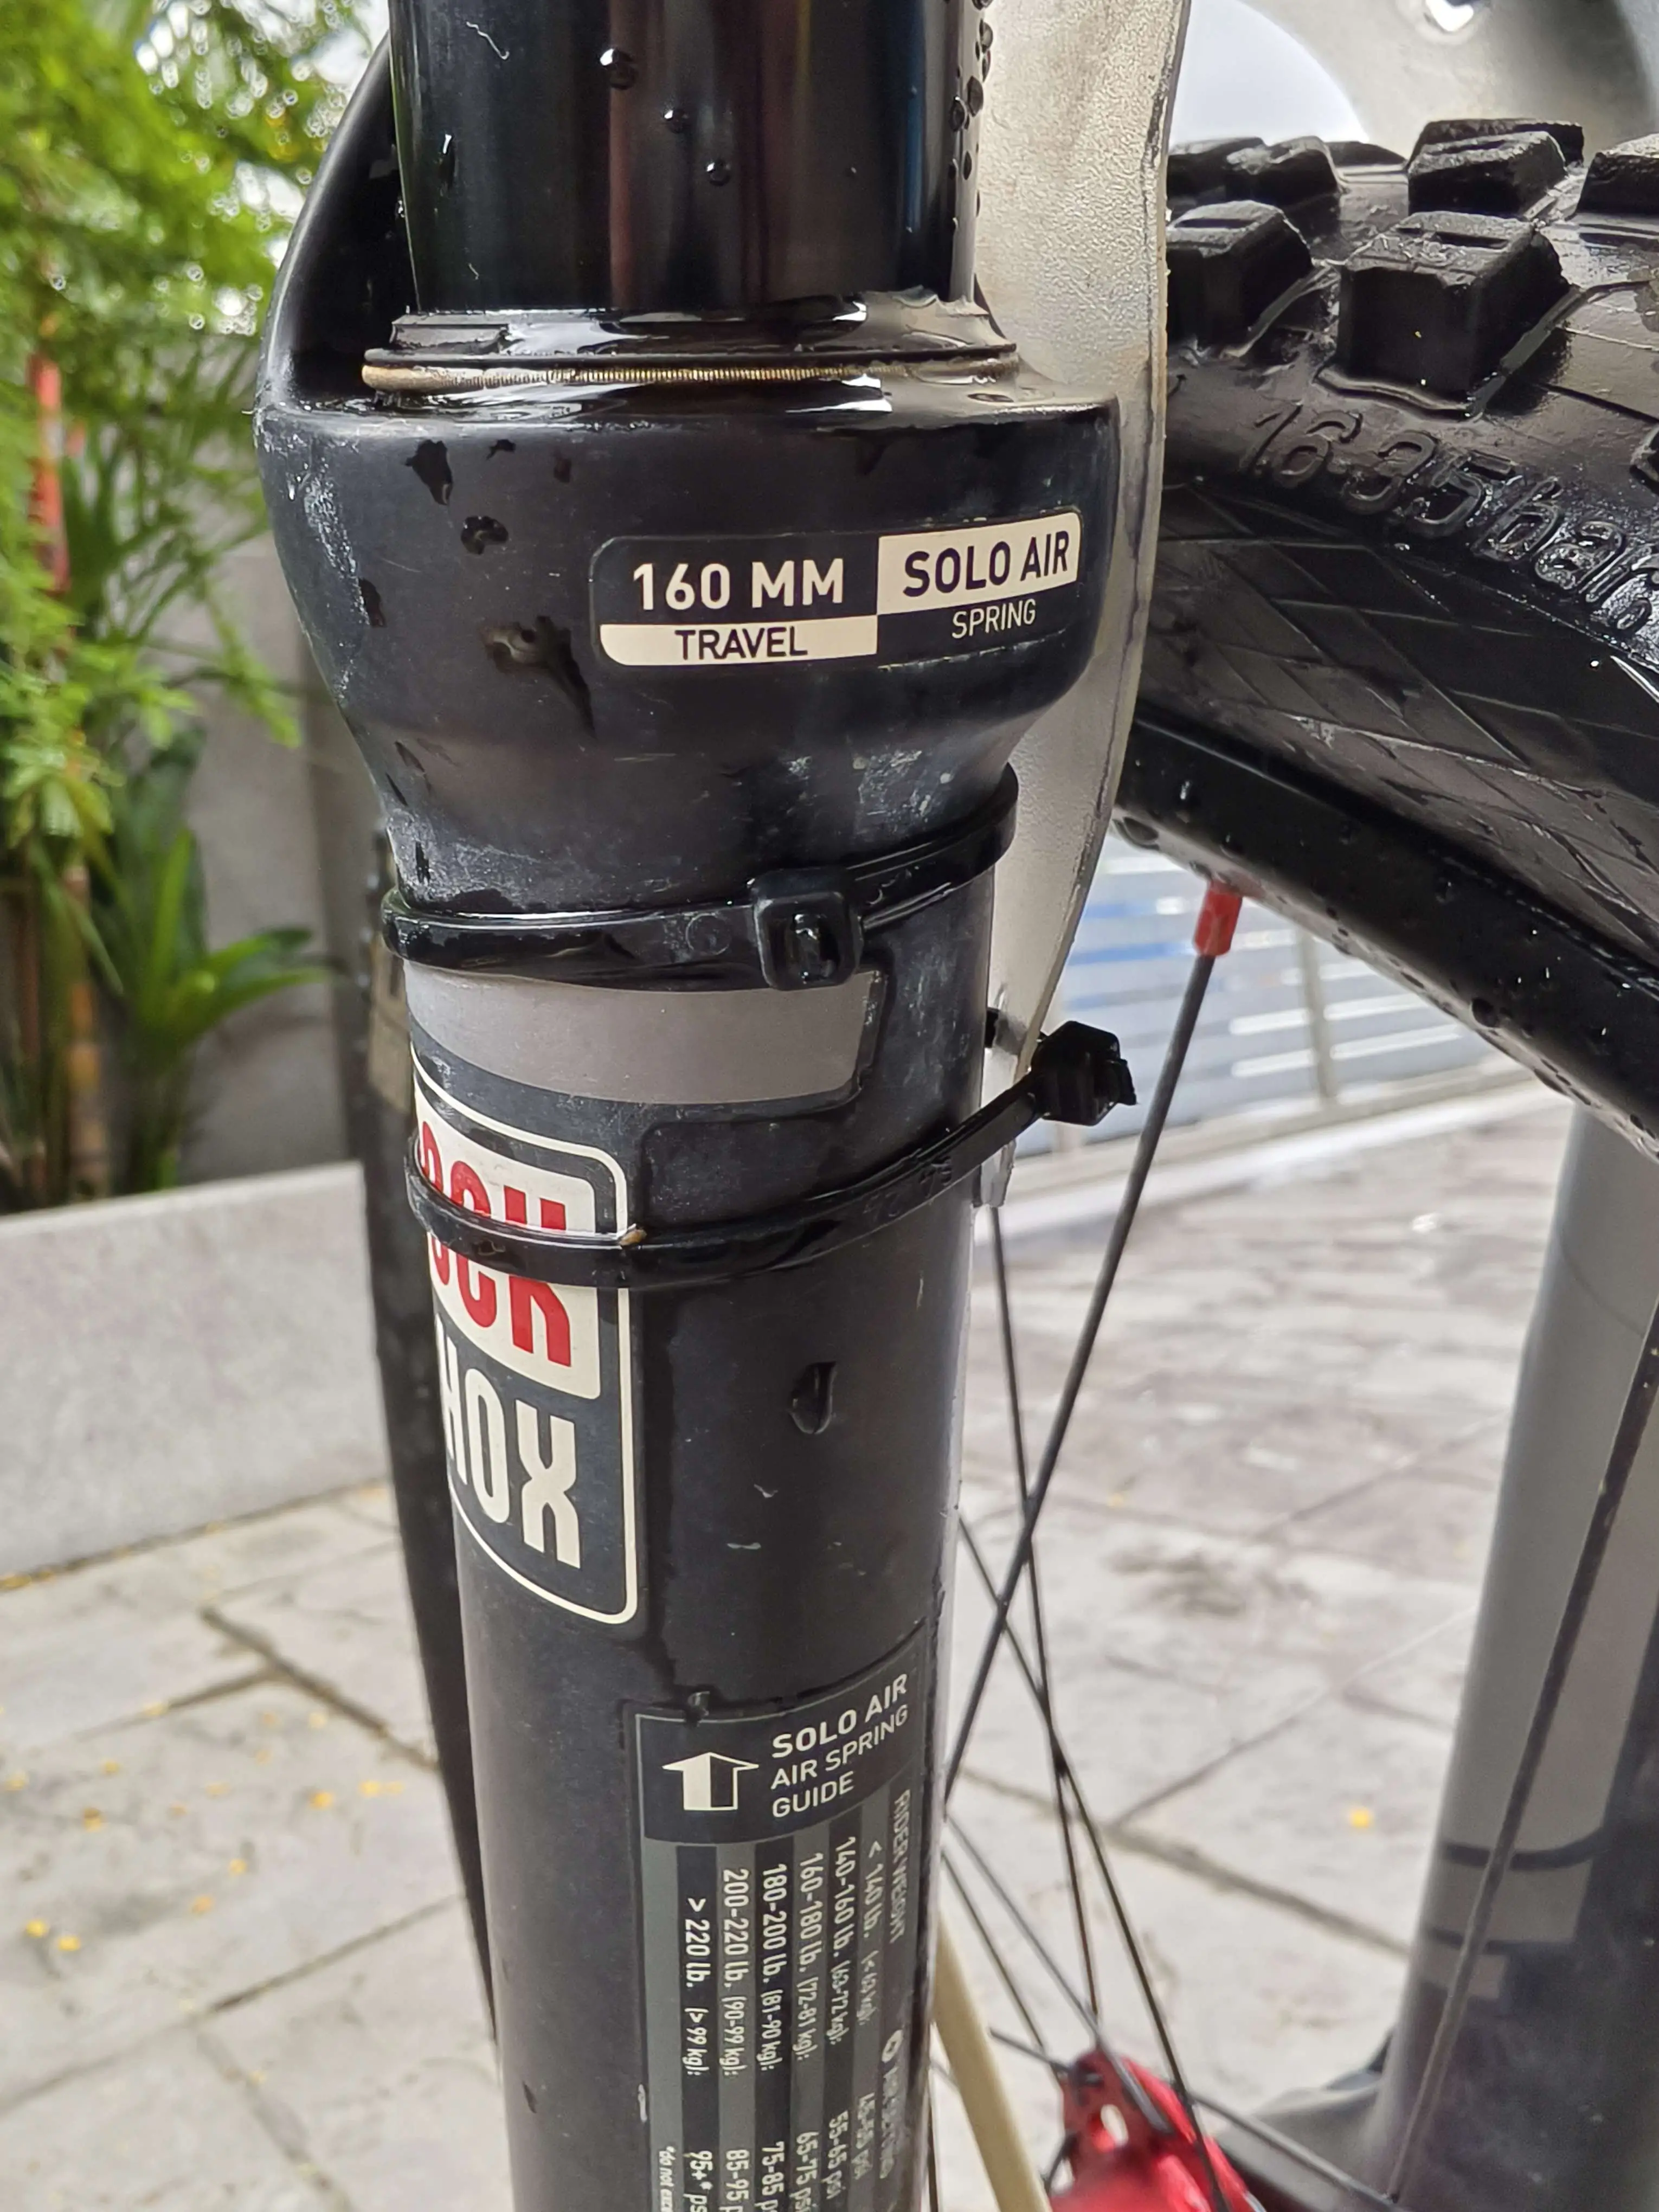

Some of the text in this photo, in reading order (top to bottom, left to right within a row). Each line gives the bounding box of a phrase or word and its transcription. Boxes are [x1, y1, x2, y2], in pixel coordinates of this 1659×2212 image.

[902, 530, 1070, 598] SOLO AIR
[632, 558, 844, 610] 160 MM
[951, 599, 1036, 640] SPRING
[674, 627, 808, 660] TRAVEL
[771, 1673, 908, 1759] SOLO AIR
[771, 1704, 908, 1790] AIR SPRING
[772, 1770, 854, 1818] GUIDE
[892, 1789, 911, 1864] RIDER
[799, 1852, 824, 1940] 160-180
[834, 1836, 856, 1925] 140-160
[865, 1863, 884, 1899] 140
[687, 1898, 706, 1912] >
[723, 1868, 749, 1956] 200-220
[762, 1863, 788, 1950] 180-200
[863, 1902, 883, 1938] lb.
[685, 1919, 711, 1956] 220
[799, 1941, 822, 1973] lb.
[833, 1924, 854, 1958] lb.
[685, 1963, 711, 1988] lb.
[724, 1961, 749, 1988] lb.
[762, 1953, 787, 1983] lb.
[721, 1997, 747, 2044] (90-99
[761, 1989, 783, 2039] (81-90
[796, 1977, 819, 2028] (72-81
[686, 2027, 708, 2045] 99
[793, 2028, 818, 2061] kg):
[826, 2011, 850, 2045] kg):
[682, 2048, 710, 2076] kg):
[719, 2047, 748, 2076] kg):
[756, 2041, 783, 2071] kg):
[795, 2131, 820, 2185] 65-75
[828, 2110, 848, 2169] 55-65
[659, 2166, 674, 2187] not
[725, 2149, 750, 2201] 85-95
[761, 2141, 785, 2196] 75-85
[821, 2170, 847, 2200] psi
